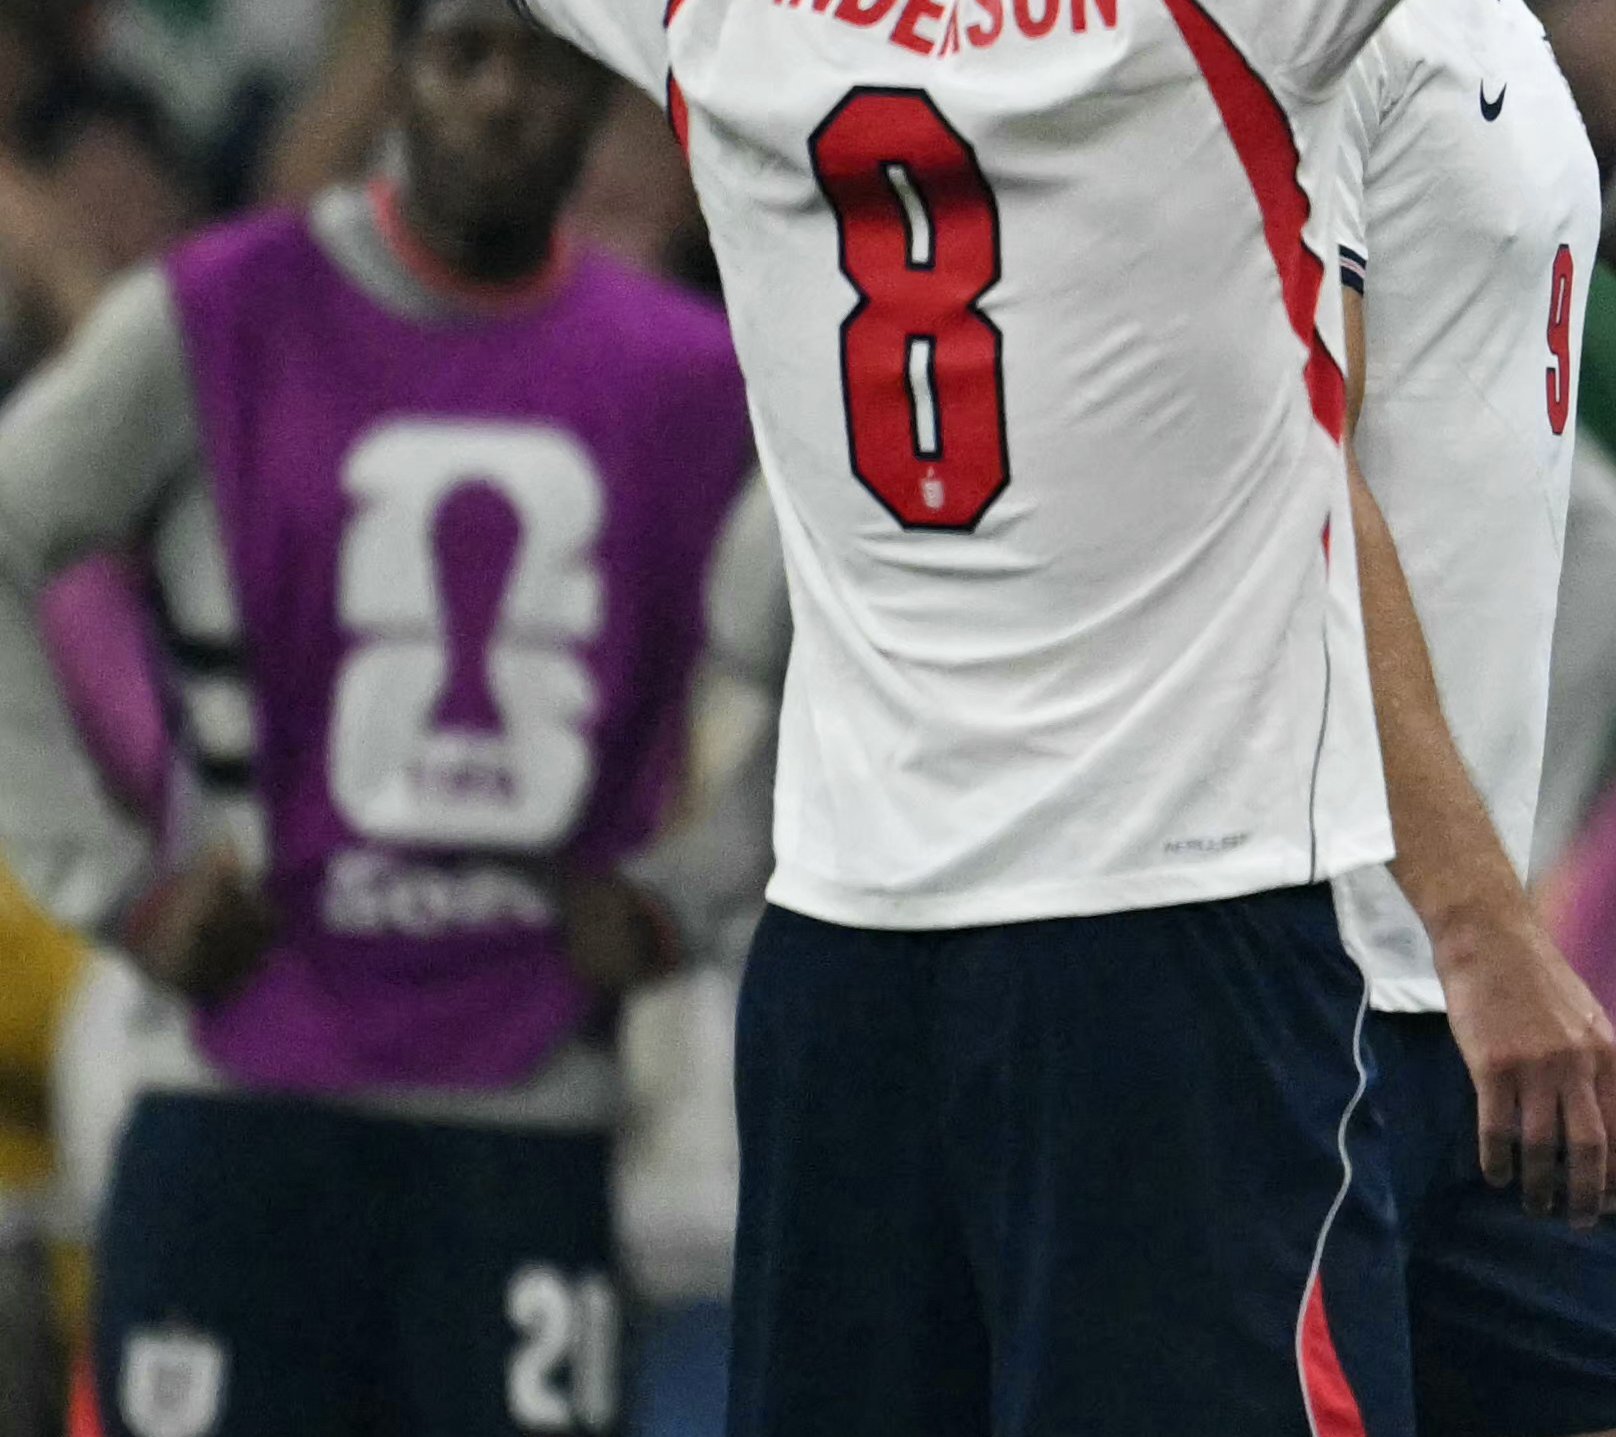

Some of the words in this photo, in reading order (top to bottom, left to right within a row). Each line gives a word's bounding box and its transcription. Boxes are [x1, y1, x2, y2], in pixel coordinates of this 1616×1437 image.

[808, 86, 1011, 532] 8
[1545, 243, 1574, 436] 9
[503, 1263, 620, 1432] 21
